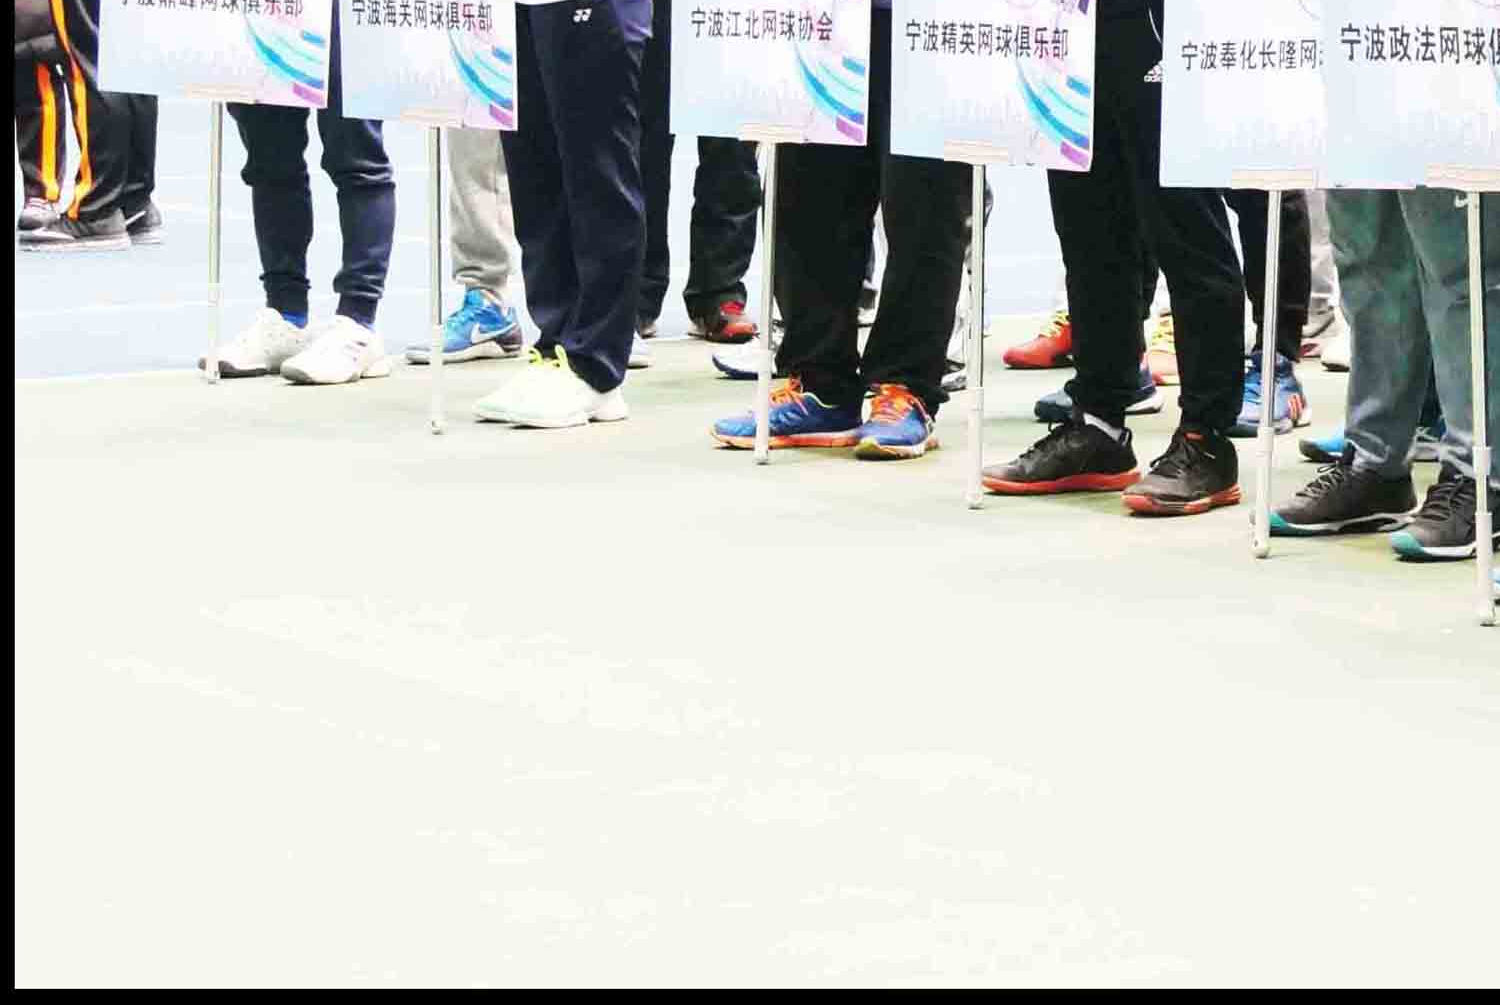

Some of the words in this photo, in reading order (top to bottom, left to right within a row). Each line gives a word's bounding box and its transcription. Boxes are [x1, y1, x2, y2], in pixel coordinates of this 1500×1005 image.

[691, 8, 833, 42] 宁波江北网球协会
[905, 19, 1069, 60] 宁波精英网球俱乐部
[1181, 39, 1324, 71] 宁波奉化长隆网
